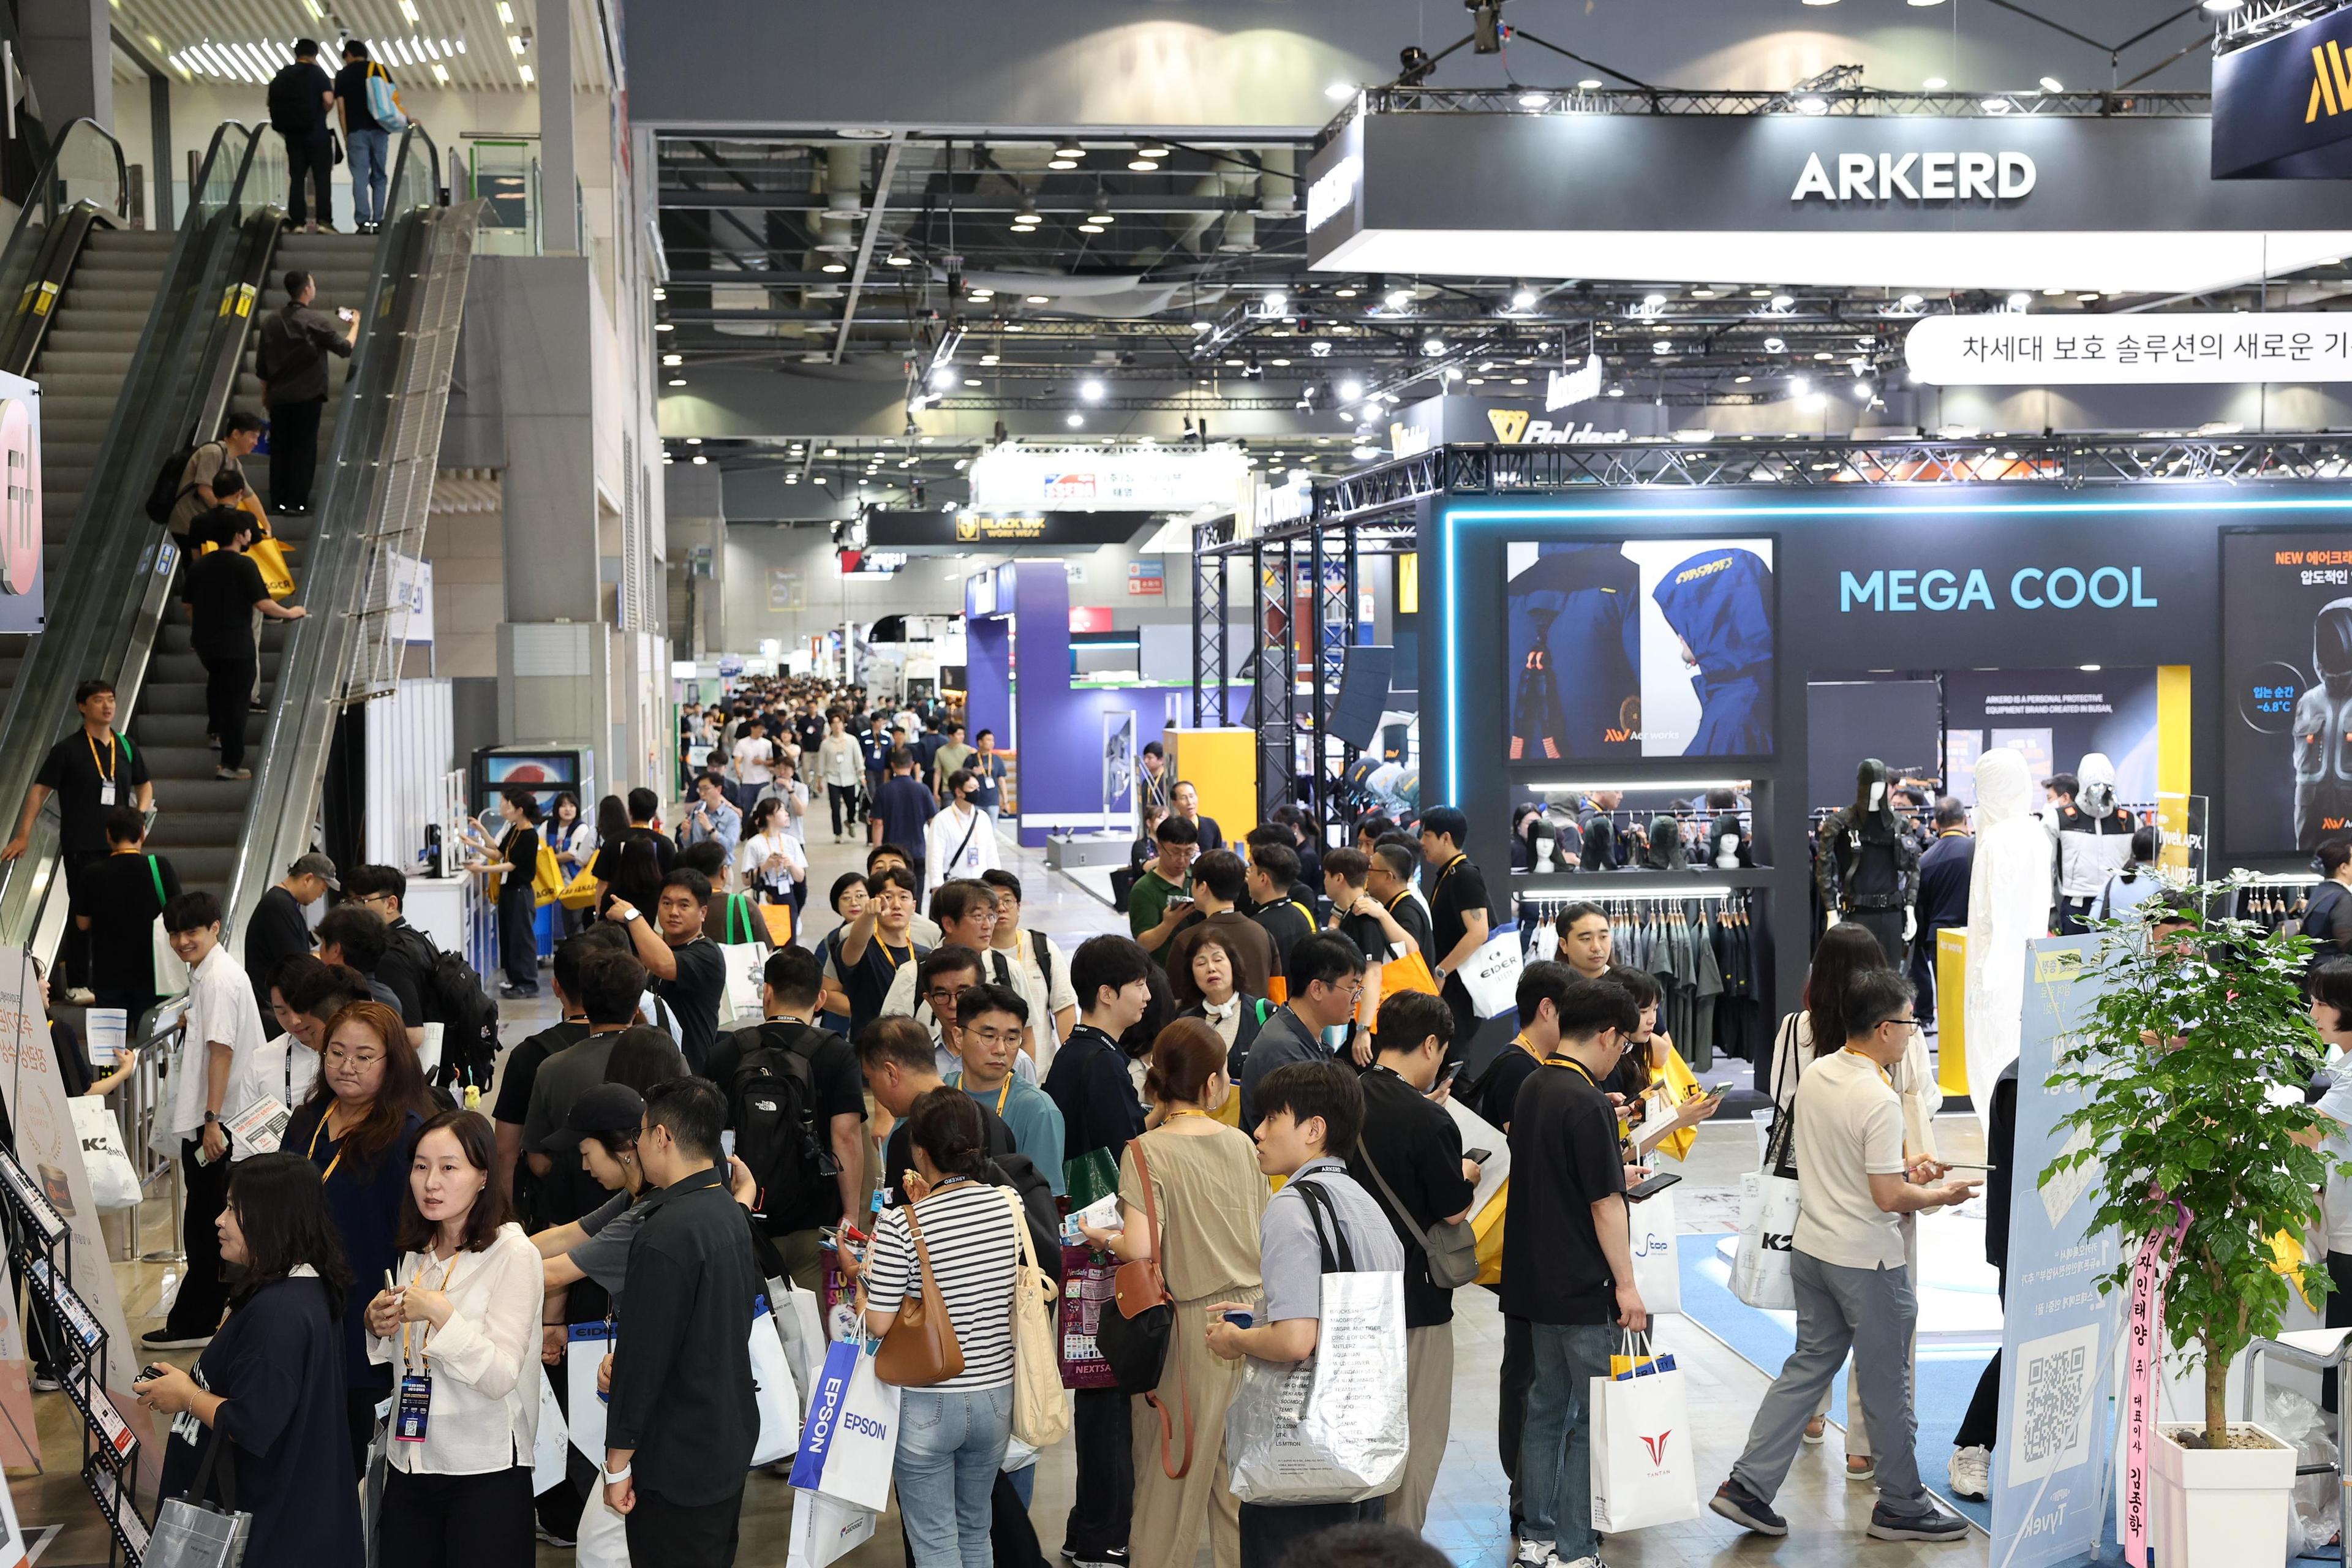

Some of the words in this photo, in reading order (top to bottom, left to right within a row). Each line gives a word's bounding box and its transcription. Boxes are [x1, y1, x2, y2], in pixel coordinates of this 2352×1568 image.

[1791, 151, 2037, 200] ARKERD
[1963, 335, 2042, 364] 차세대
[2054, 334, 2106, 361] 보호
[2116, 334, 2223, 364] 솔루션의
[2234, 333, 2313, 361] 새로운
[2325, 331, 2352, 359] 기
[2275, 551, 2302, 564] NEW
[1675, 557, 1733, 585] AIRCRAFT
[2301, 570, 2348, 584] 압도적인
[1840, 568, 1995, 612] MEGA
[2010, 566, 2157, 609] COOL
[1986, 695, 2013, 704] ARKERD
[2013, 695, 2020, 703] IS
[2027, 694, 2062, 703] PERSONAL
[2063, 694, 2103, 703] PROTECTIVE
[2253, 686, 2273, 699] 입는
[2274, 685, 2294, 699] 순간
[1986, 706, 2024, 715] EQUIPMENT
[2025, 705, 2048, 714] BRAND
[2049, 705, 2079, 714] CREATED
[2080, 704, 2087, 713] IN
[2087, 704, 2113, 714] BUSAN,
[2256, 700, 2291, 712] -6.8°C
[1480, 957, 1517, 978] EIDER
[1101, 1036, 1116, 1050] ARKERD
[944, 1175, 966, 1184] ARKERD
[2132, 1356, 2146, 1382] (주)
[809, 1378, 842, 1453] EPSON
[844, 1412, 886, 1441] EPSON
[2133, 1394, 2142, 1455] 대표이사
[2128, 1468, 2143, 1538] 김종학
